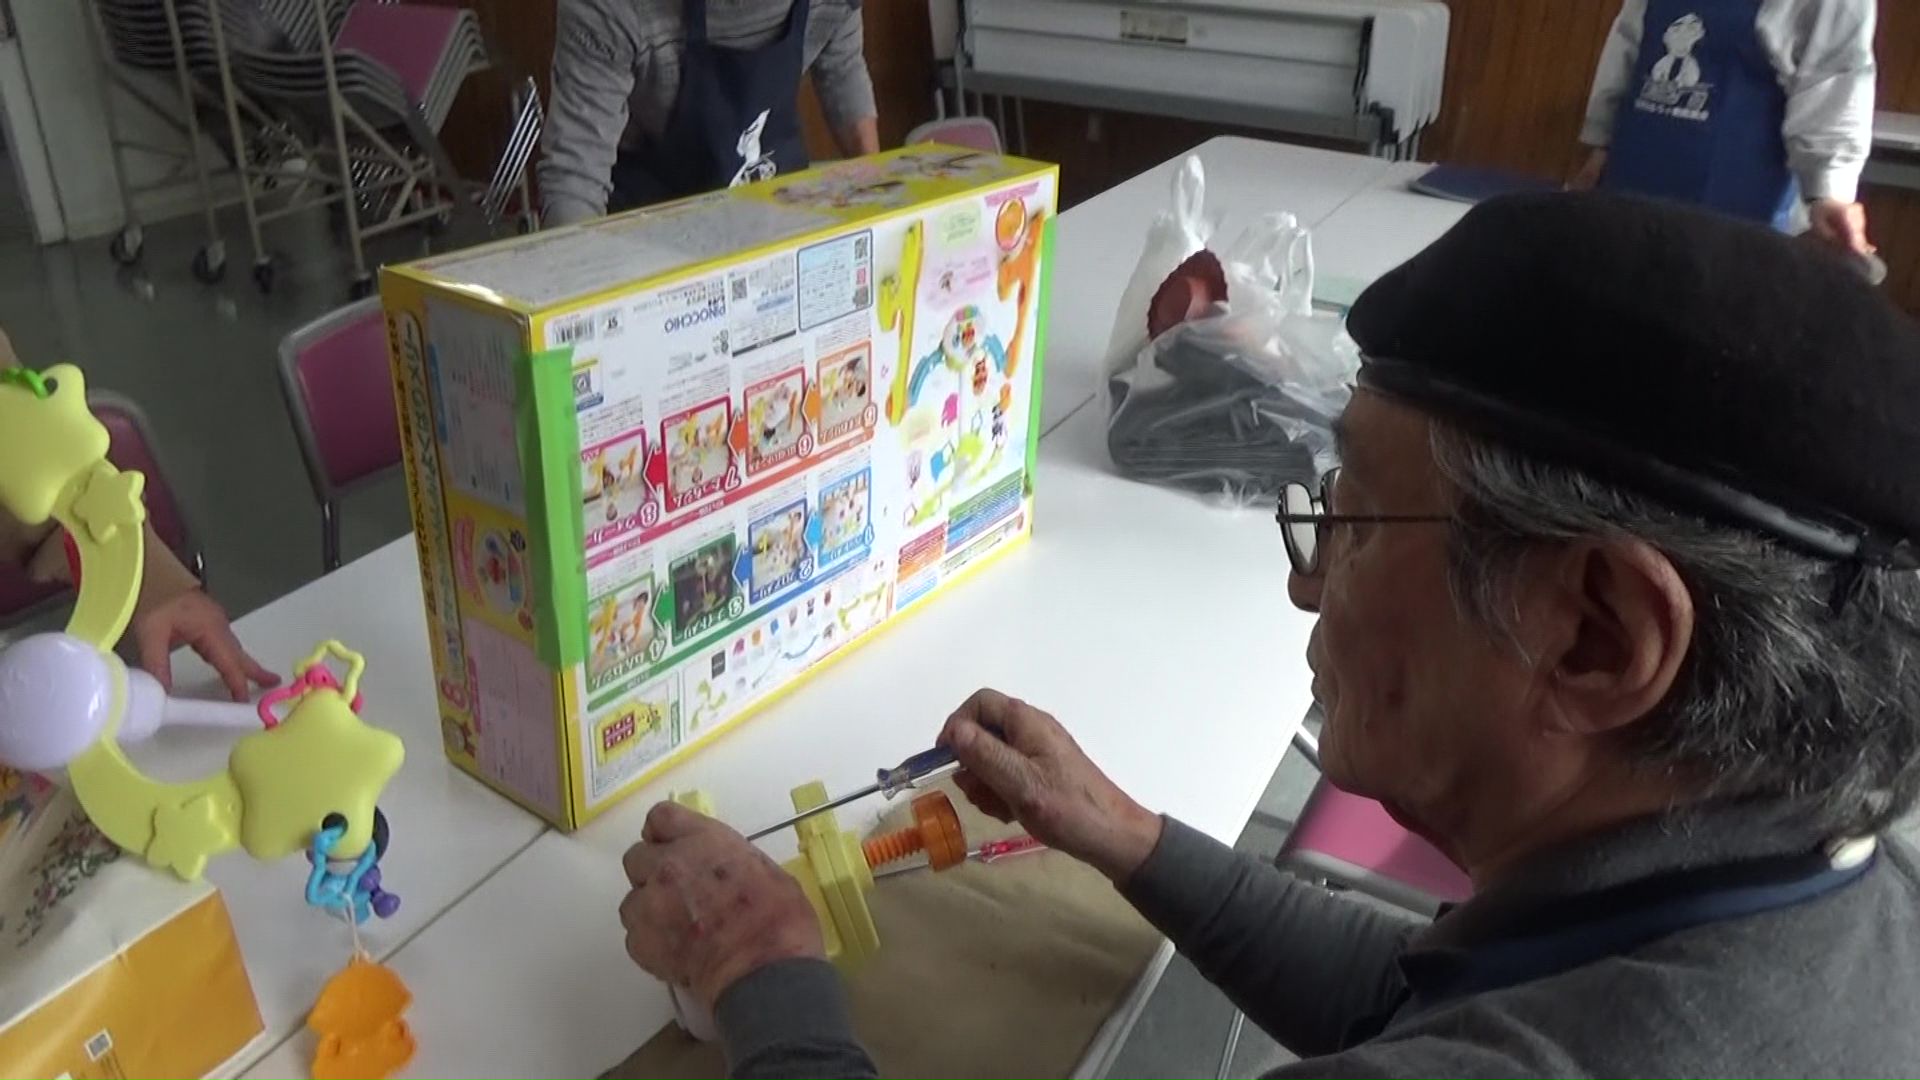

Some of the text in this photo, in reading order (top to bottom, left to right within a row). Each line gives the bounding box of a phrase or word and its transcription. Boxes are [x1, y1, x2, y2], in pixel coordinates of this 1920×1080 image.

[664, 305, 725, 333] PINOCCHIO
[724, 464, 738, 490] 7
[672, 476, 720, 510] たっちジム
[640, 500, 657, 529] 8
[799, 556, 812, 581] 2
[675, 594, 742, 642] 3 ナイトメリー
[649, 635, 664, 663] 4
